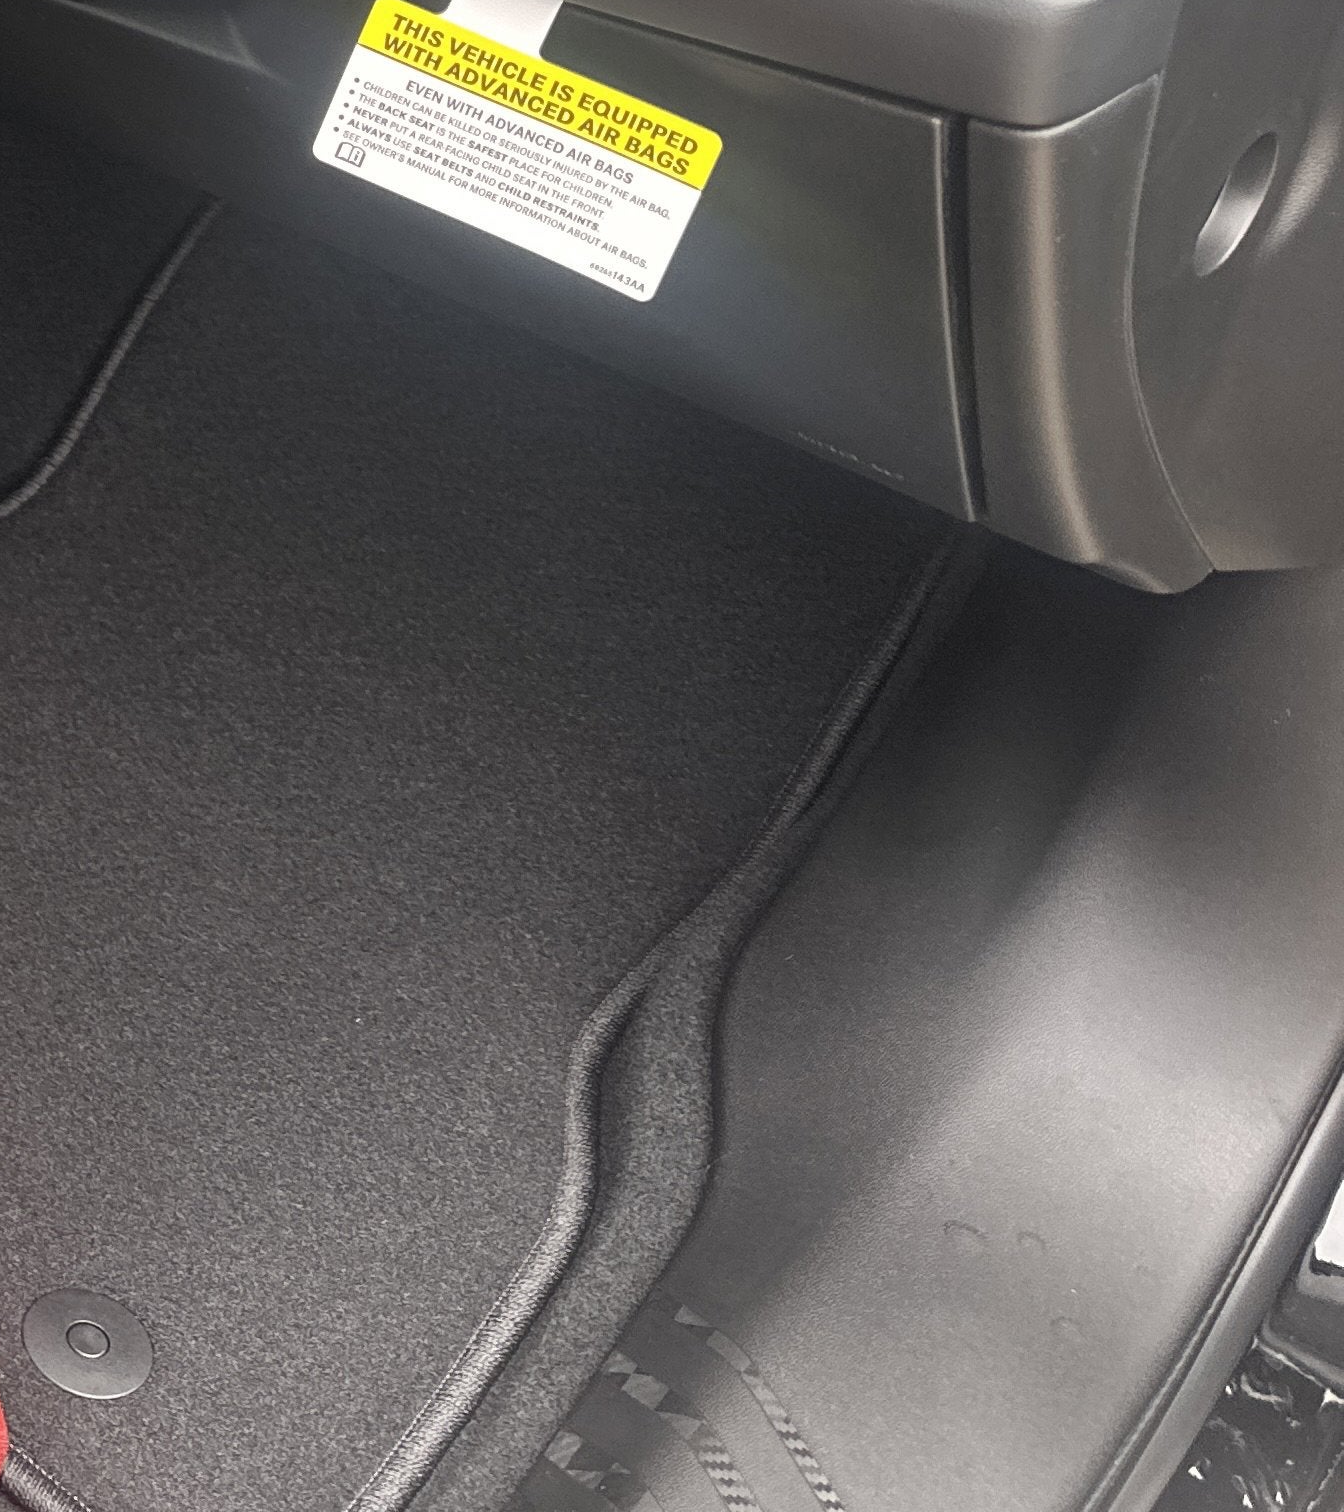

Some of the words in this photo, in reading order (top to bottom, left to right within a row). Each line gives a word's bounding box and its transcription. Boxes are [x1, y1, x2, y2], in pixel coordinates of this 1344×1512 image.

[358, 92, 378, 108] THE
[377, 101, 409, 121] BACK
[408, 115, 436, 132] SEAT
[447, 130, 468, 146] THE
[466, 139, 509, 162] SAFEST
[508, 156, 541, 177] PLACE
[540, 170, 562, 186] FOR
[384, 32, 443, 72] WITH
[444, 62, 575, 125] ADVANCED
[577, 117, 621, 146] AIR
[624, 135, 690, 176] BAGS
[393, 13, 445, 48] THIS
[450, 37, 548, 92] VEHICLE
[548, 80, 575, 103] IS
[577, 92, 698, 155] EQUIPPED
[405, 79, 444, 105] EVEN
[446, 95, 484, 122] WITH
[484, 114, 565, 154] ADVANCED
[565, 147, 592, 167] AIR
[593, 158, 634, 185] BAGS
[342, 130, 362, 144] SEE
[405, 156, 446, 181] MANUAL
[447, 174, 469, 190] FOR
[468, 183, 499, 203] MORE
[498, 196, 567, 232] INFORMATION
[566, 226, 602, 247] ABOUT
[600, 241, 619, 256] AIR
[346, 118, 392, 143] ALWAYS
[392, 136, 413, 152] USE
[412, 146, 442, 163] SEAT
[440, 157, 474, 178] BELTS
[474, 172, 497, 187] AND
[497, 181, 532, 202] CHILD
[352, 105, 389, 127] NEVER
[389, 121, 410, 135] PUT
[481, 160, 512, 179] CHILD
[512, 173, 538, 190] SEAT
[551, 189, 571, 204] THE
[363, 81, 412, 108] CHILDREN
[411, 102, 433, 117] CAN
[447, 116, 482, 137] KILLED
[498, 138, 553, 166] SERIOUSLY
[552, 160, 594, 184] INJURED
[610, 184, 630, 201] THE
[628, 195, 648, 209] AIR
